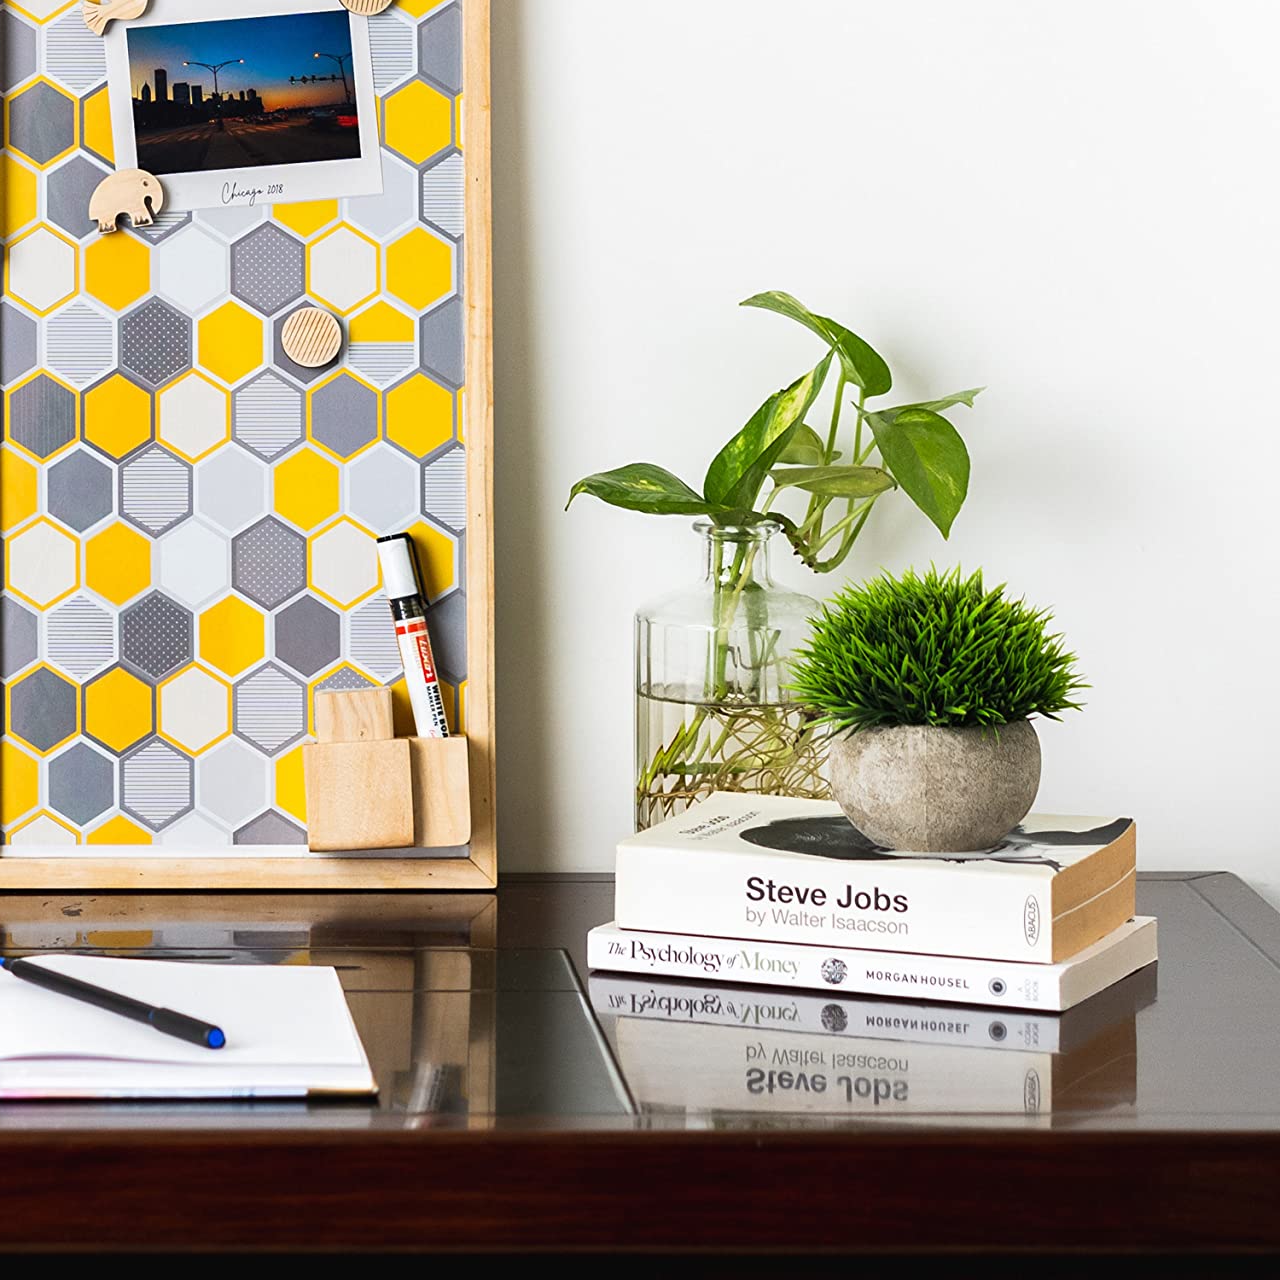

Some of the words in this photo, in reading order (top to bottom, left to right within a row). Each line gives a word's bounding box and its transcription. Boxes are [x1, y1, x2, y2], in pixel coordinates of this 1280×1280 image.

[221, 181, 264, 207] Chicago
[267, 183, 284, 195] 2018
[426, 686, 436, 712] MARKER
[432, 685, 444, 717] WHITE
[746, 876, 827, 907] Steve
[836, 884, 909, 913] Jobs
[746, 905, 767, 927] by
[771, 908, 827, 928] Walter
[831, 914, 909, 935] Isaacson
[1027, 901, 1036, 940] ABACUS
[607, 941, 627, 957] The
[630, 940, 724, 972] Psychology
[726, 954, 737, 969] of
[740, 950, 800, 979] Money
[866, 970, 918, 984] MORGAN
[920, 975, 970, 989] HOUSEL
